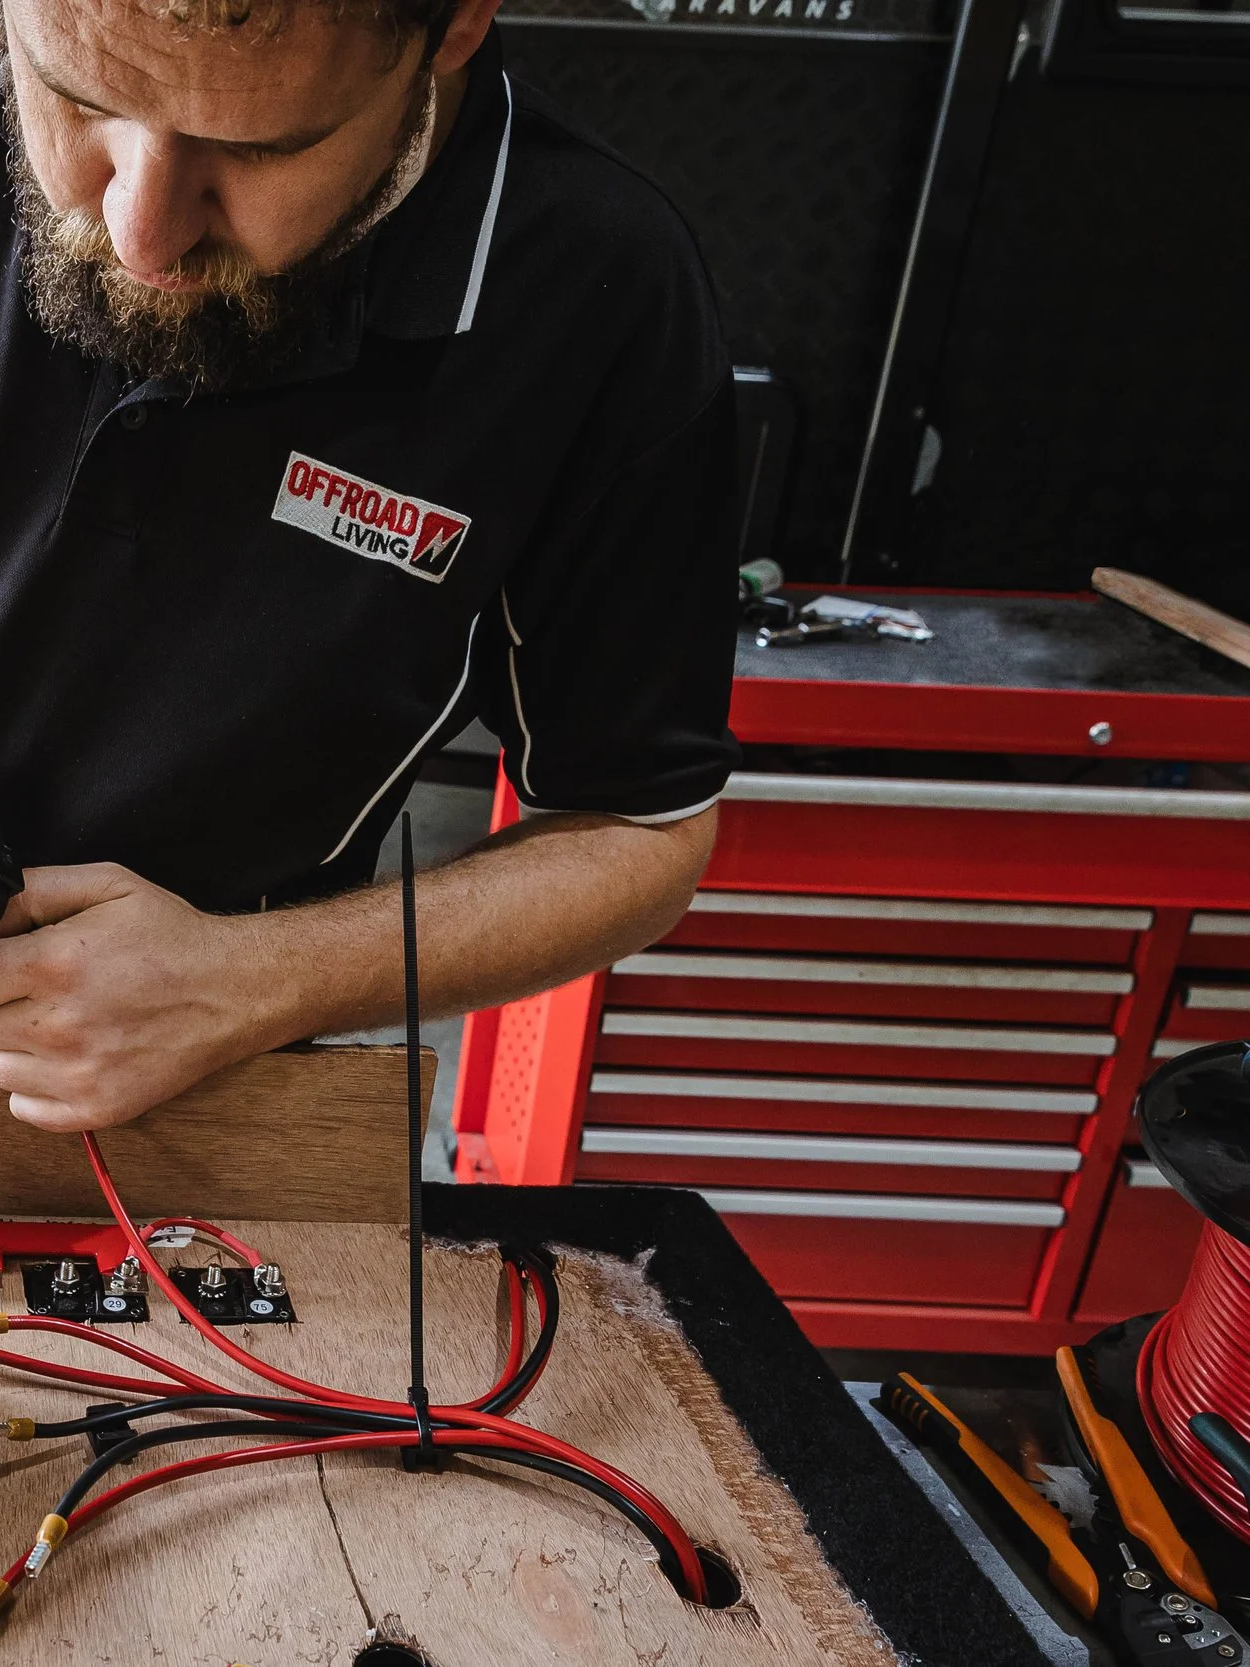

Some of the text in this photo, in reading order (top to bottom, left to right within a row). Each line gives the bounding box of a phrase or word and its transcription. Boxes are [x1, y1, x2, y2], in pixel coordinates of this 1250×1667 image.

[287, 460, 419, 537] OFFROAD
[330, 515, 409, 561] LIVING
[108, 1300, 122, 1308] 29
